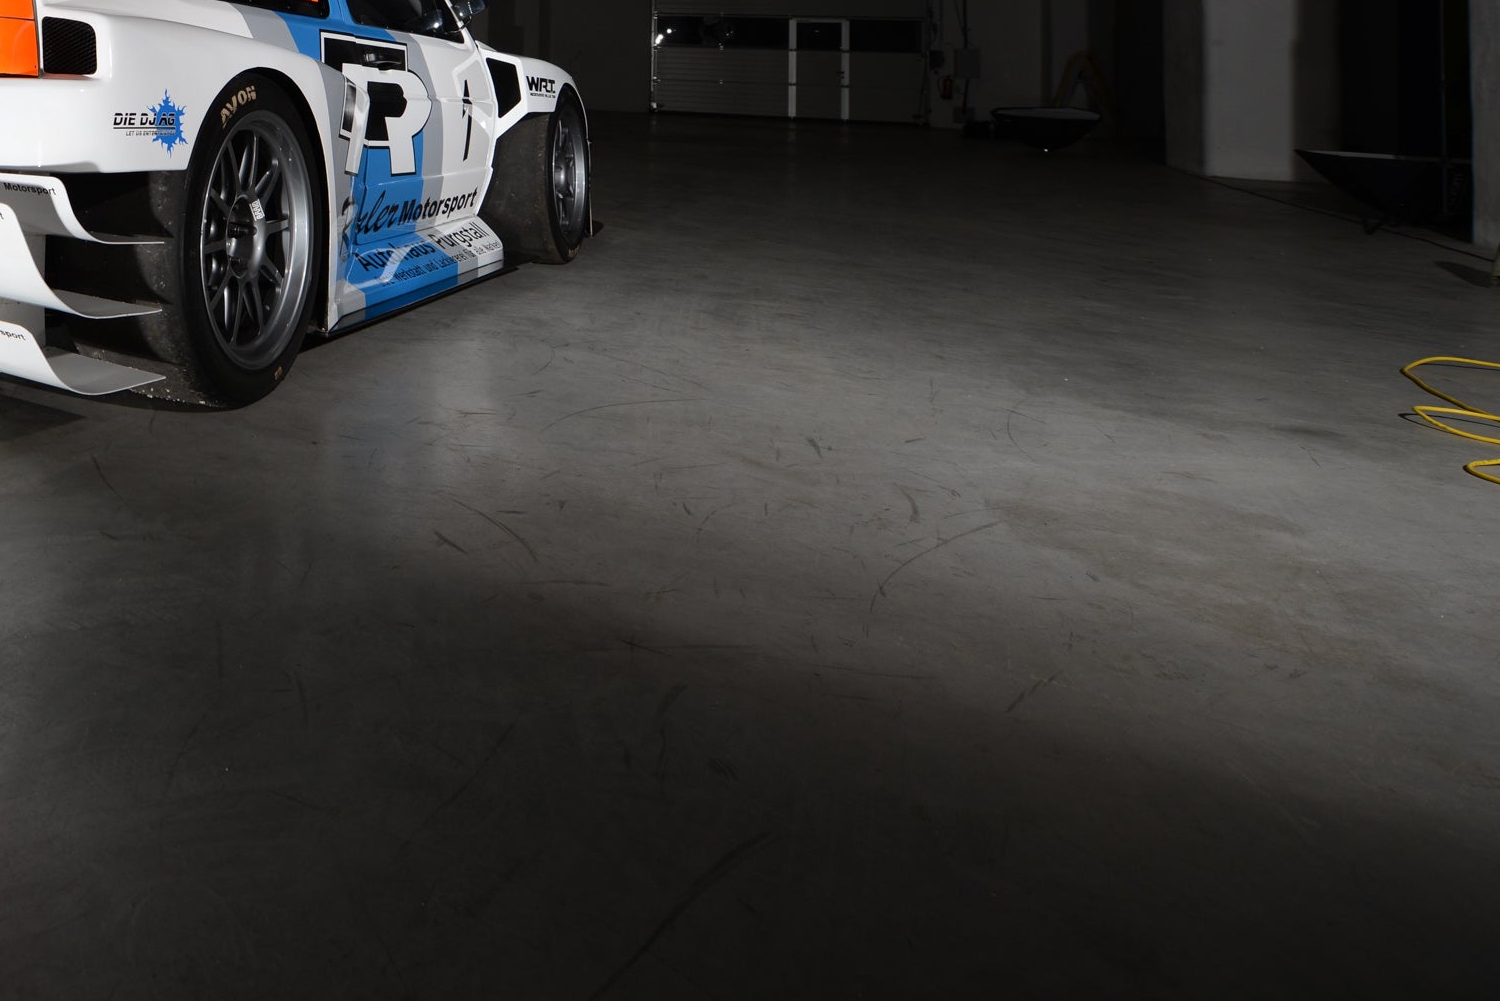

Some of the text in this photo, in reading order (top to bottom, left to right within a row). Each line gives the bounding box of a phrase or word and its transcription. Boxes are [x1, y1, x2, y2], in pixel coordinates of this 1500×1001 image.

[113, 112, 176, 126] DIE DJ AG
[220, 85, 257, 129] AVON
[3, 182, 57, 196] Motorsport
[397, 187, 478, 226] Motorsport
[352, 221, 490, 272] Autohaus Purgstall
